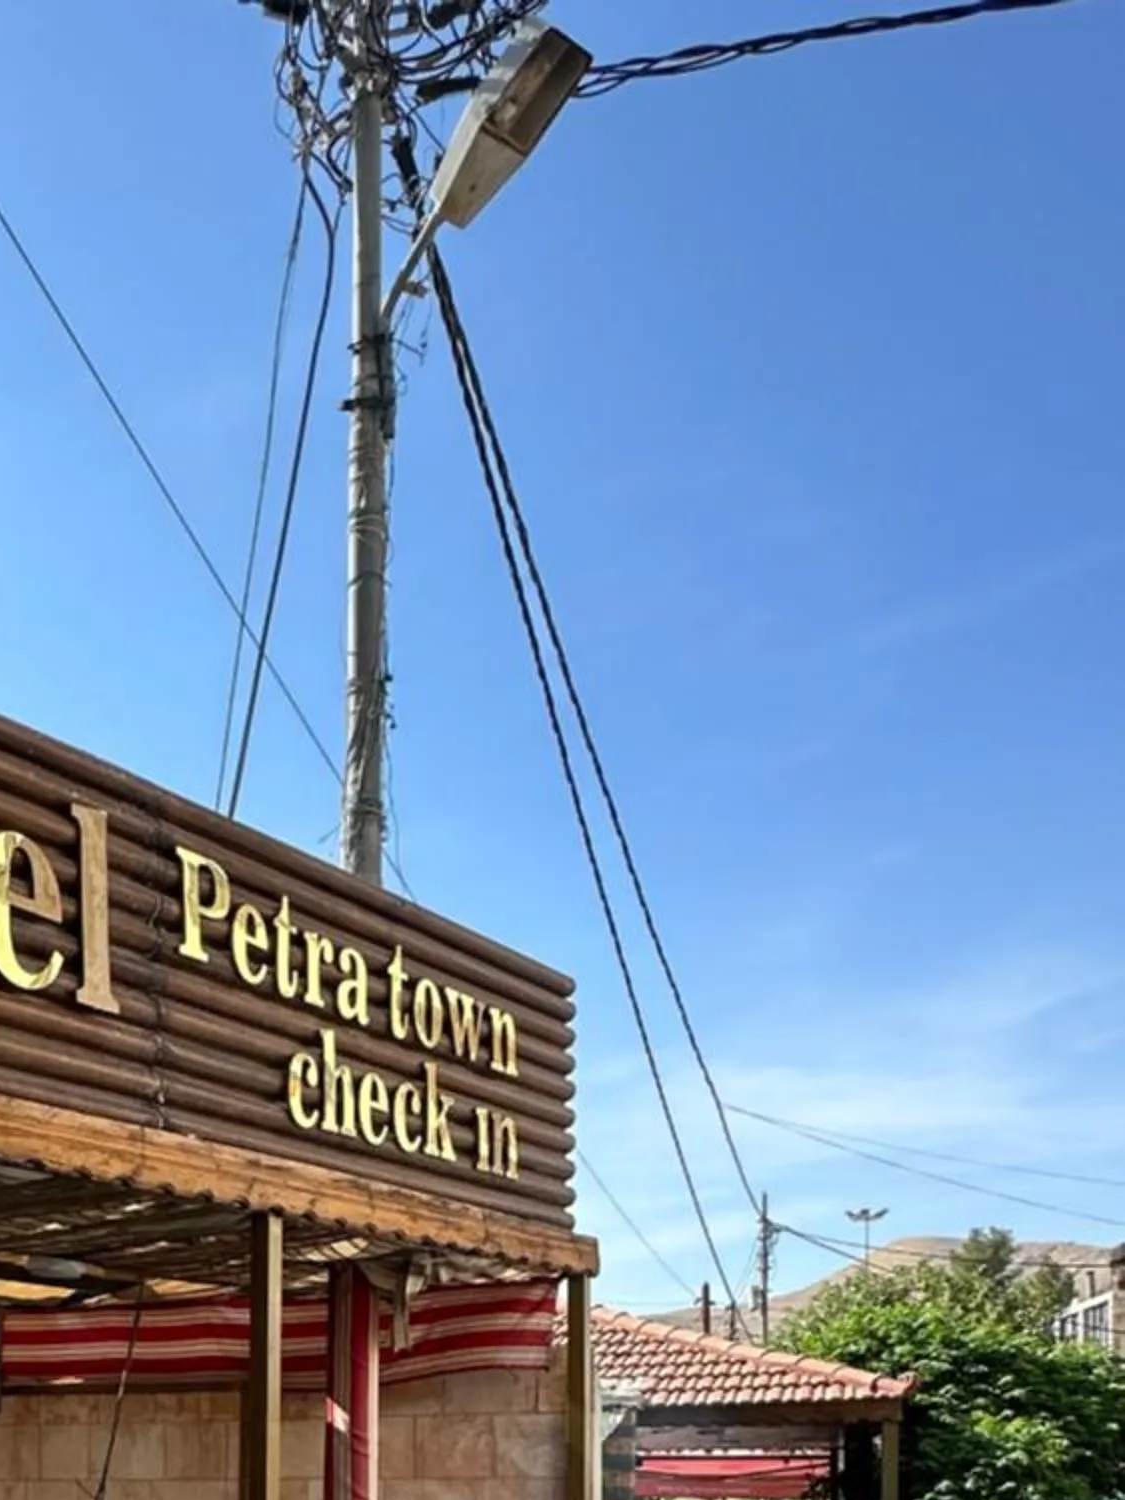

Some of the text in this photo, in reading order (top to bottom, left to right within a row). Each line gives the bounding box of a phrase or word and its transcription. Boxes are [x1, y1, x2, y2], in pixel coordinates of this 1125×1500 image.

[176, 845, 520, 1077] Petra town
[288, 1028, 520, 1180] check in
